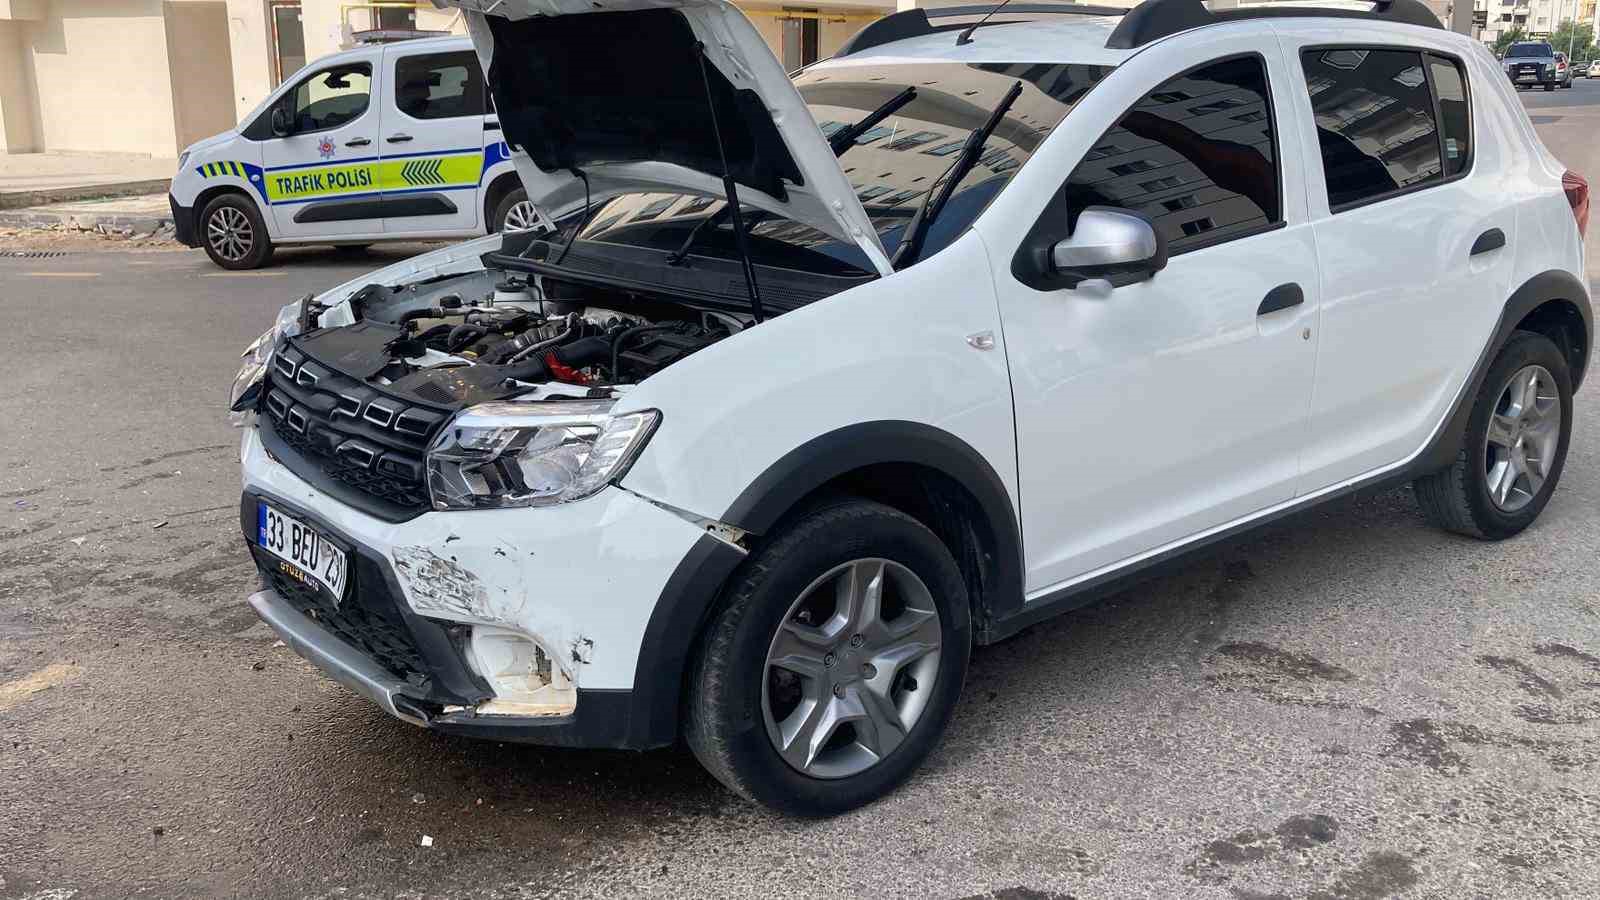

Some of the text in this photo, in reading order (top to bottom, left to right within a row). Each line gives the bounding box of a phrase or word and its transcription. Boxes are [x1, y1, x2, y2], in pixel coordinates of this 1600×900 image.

[276, 168, 372, 194] TRAFİK POLİSİ
[268, 511, 284, 552] 33
[292, 524, 319, 571] BEU
